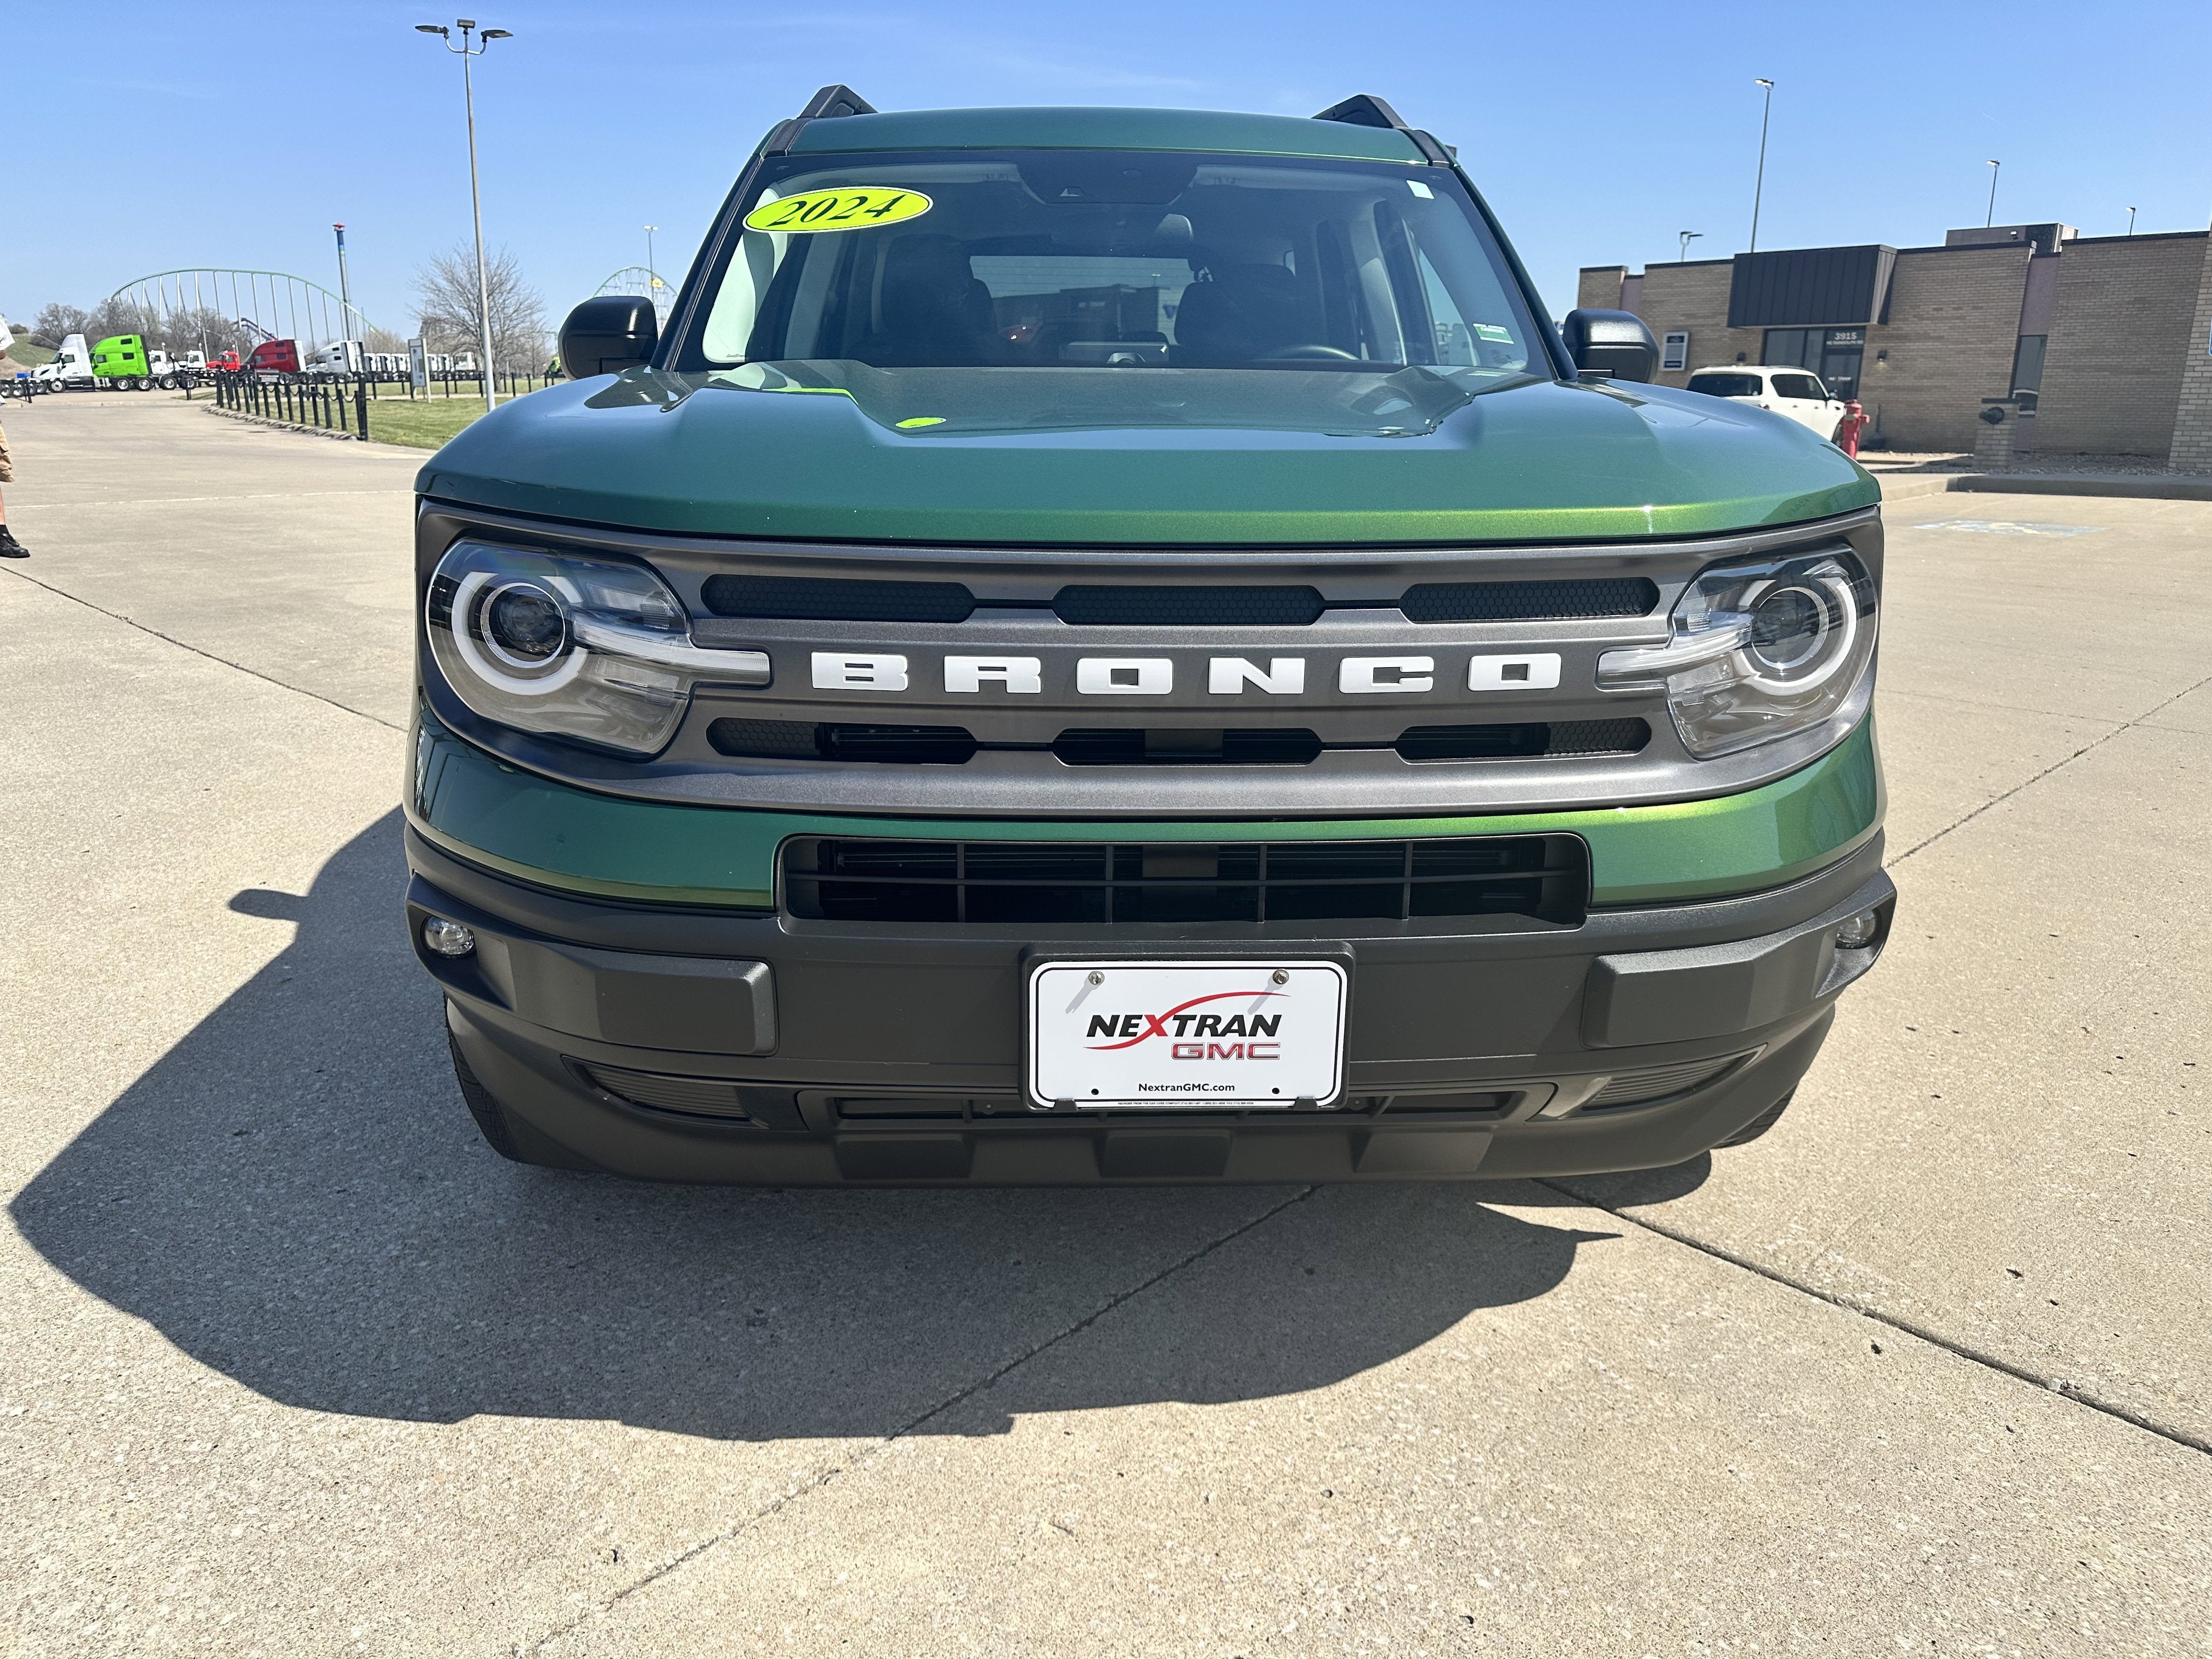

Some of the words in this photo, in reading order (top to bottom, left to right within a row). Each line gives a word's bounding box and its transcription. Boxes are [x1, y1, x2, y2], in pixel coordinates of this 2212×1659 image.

[765, 194, 907, 228] 2024
[1835, 332, 1857, 340] 3915
[810, 651, 1562, 695] BRONCO
[1086, 1014, 1282, 1037] NEXTRAN
[1171, 1041, 1280, 1060] GMC
[1138, 1082, 1235, 1092] NextranGMC.com
